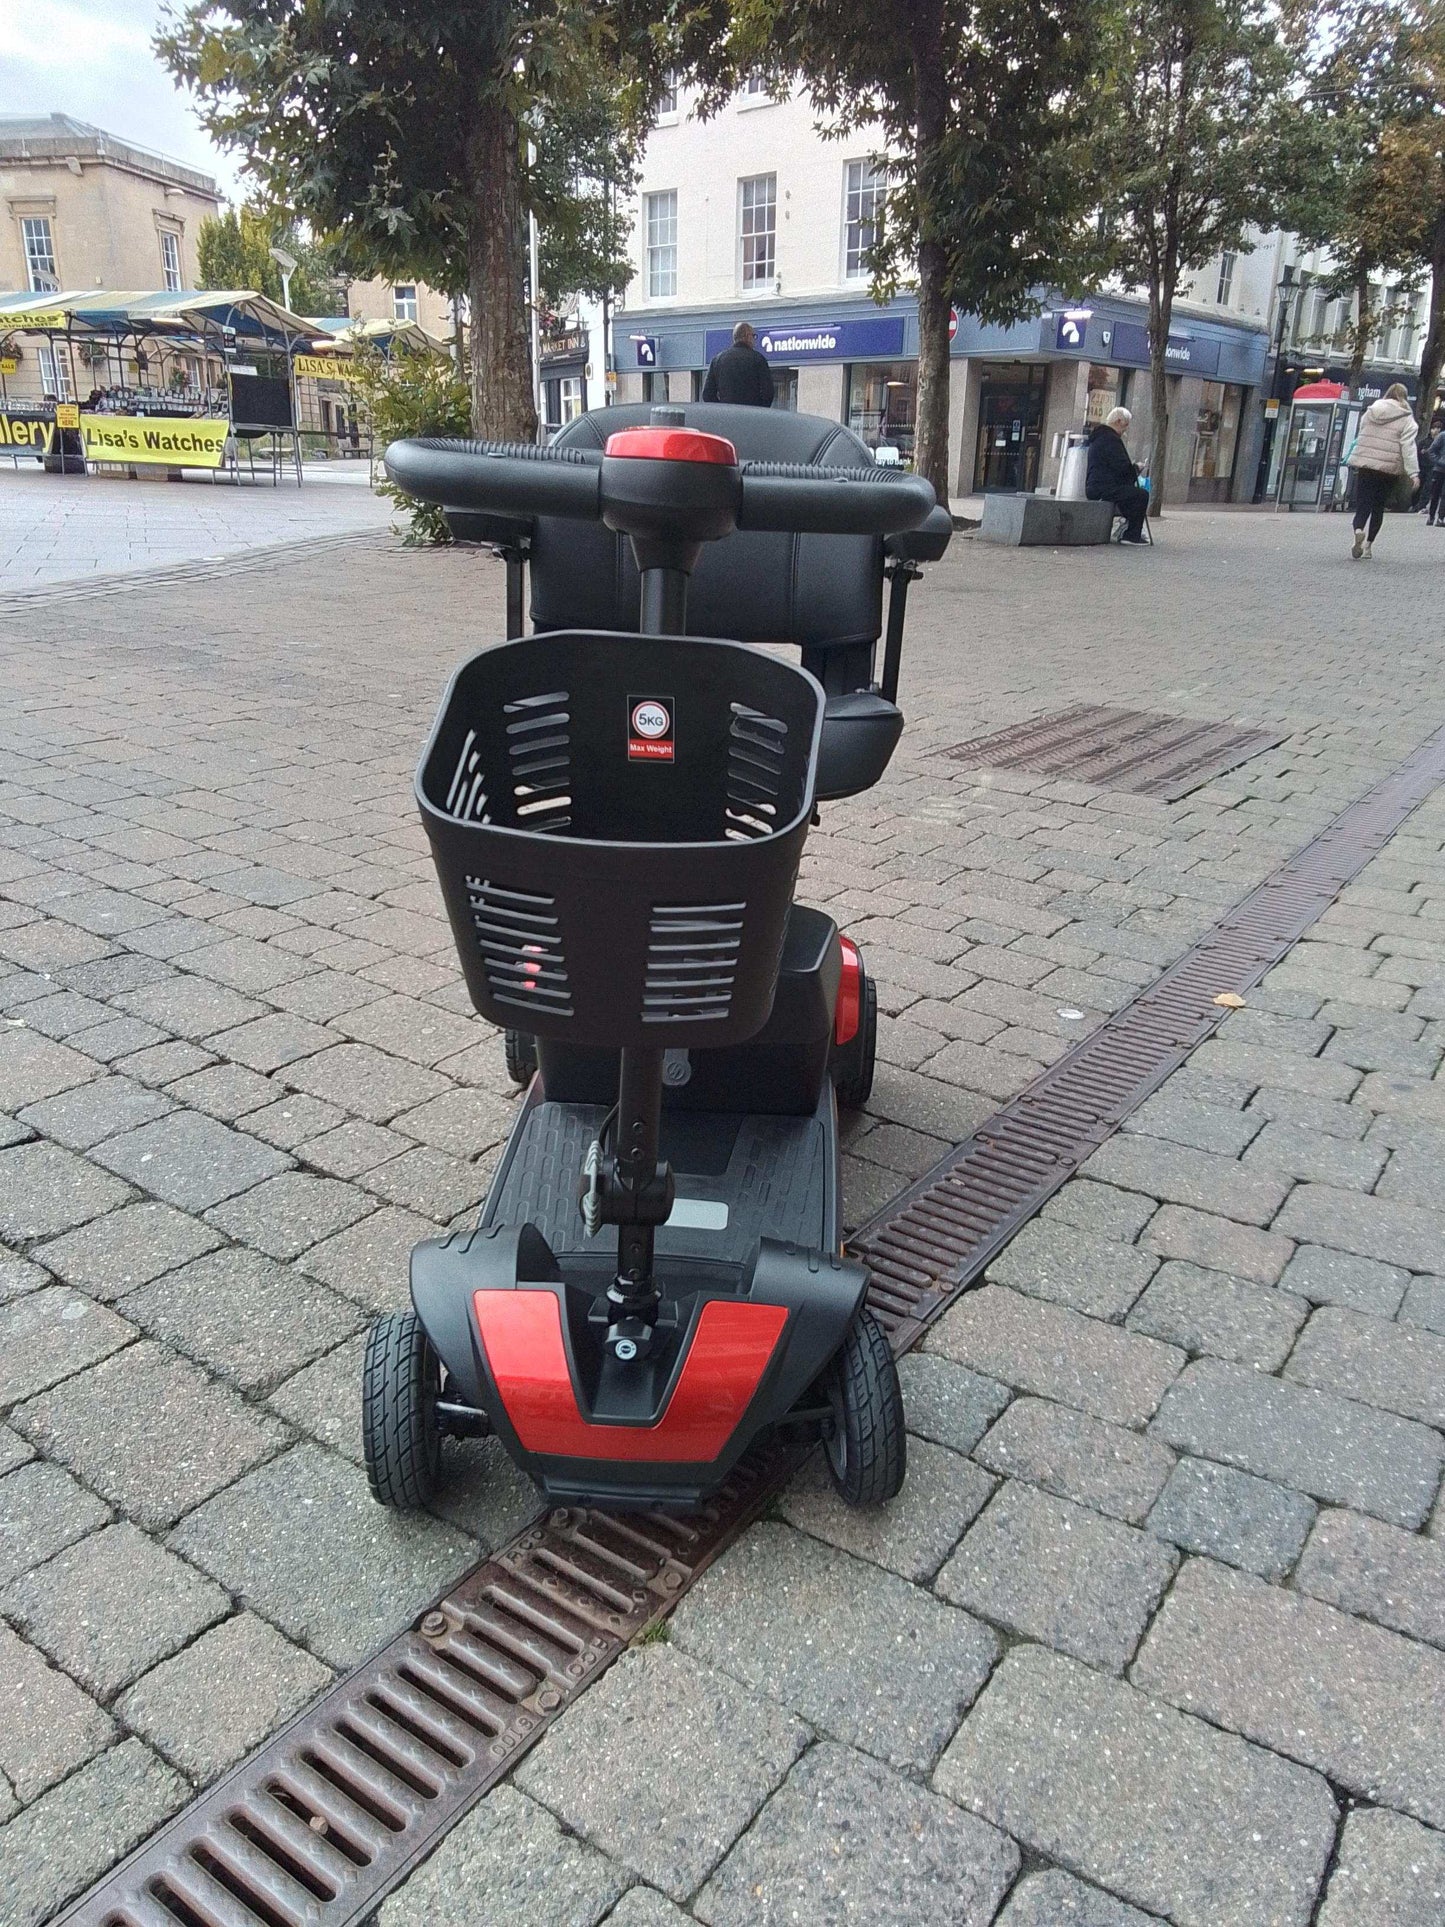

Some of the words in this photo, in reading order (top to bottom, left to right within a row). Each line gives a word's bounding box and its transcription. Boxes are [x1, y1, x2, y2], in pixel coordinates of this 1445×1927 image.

[542, 339, 566, 354] MARKET
[774, 334, 836, 352] nationwide
[298, 358, 333, 375] LISA'S
[86, 427, 139, 449] Lisa's
[142, 430, 224, 453] Watches
[638, 712, 664, 727] 5KG
[629, 743, 645, 752] Max
[646, 744, 673, 755] Weight
